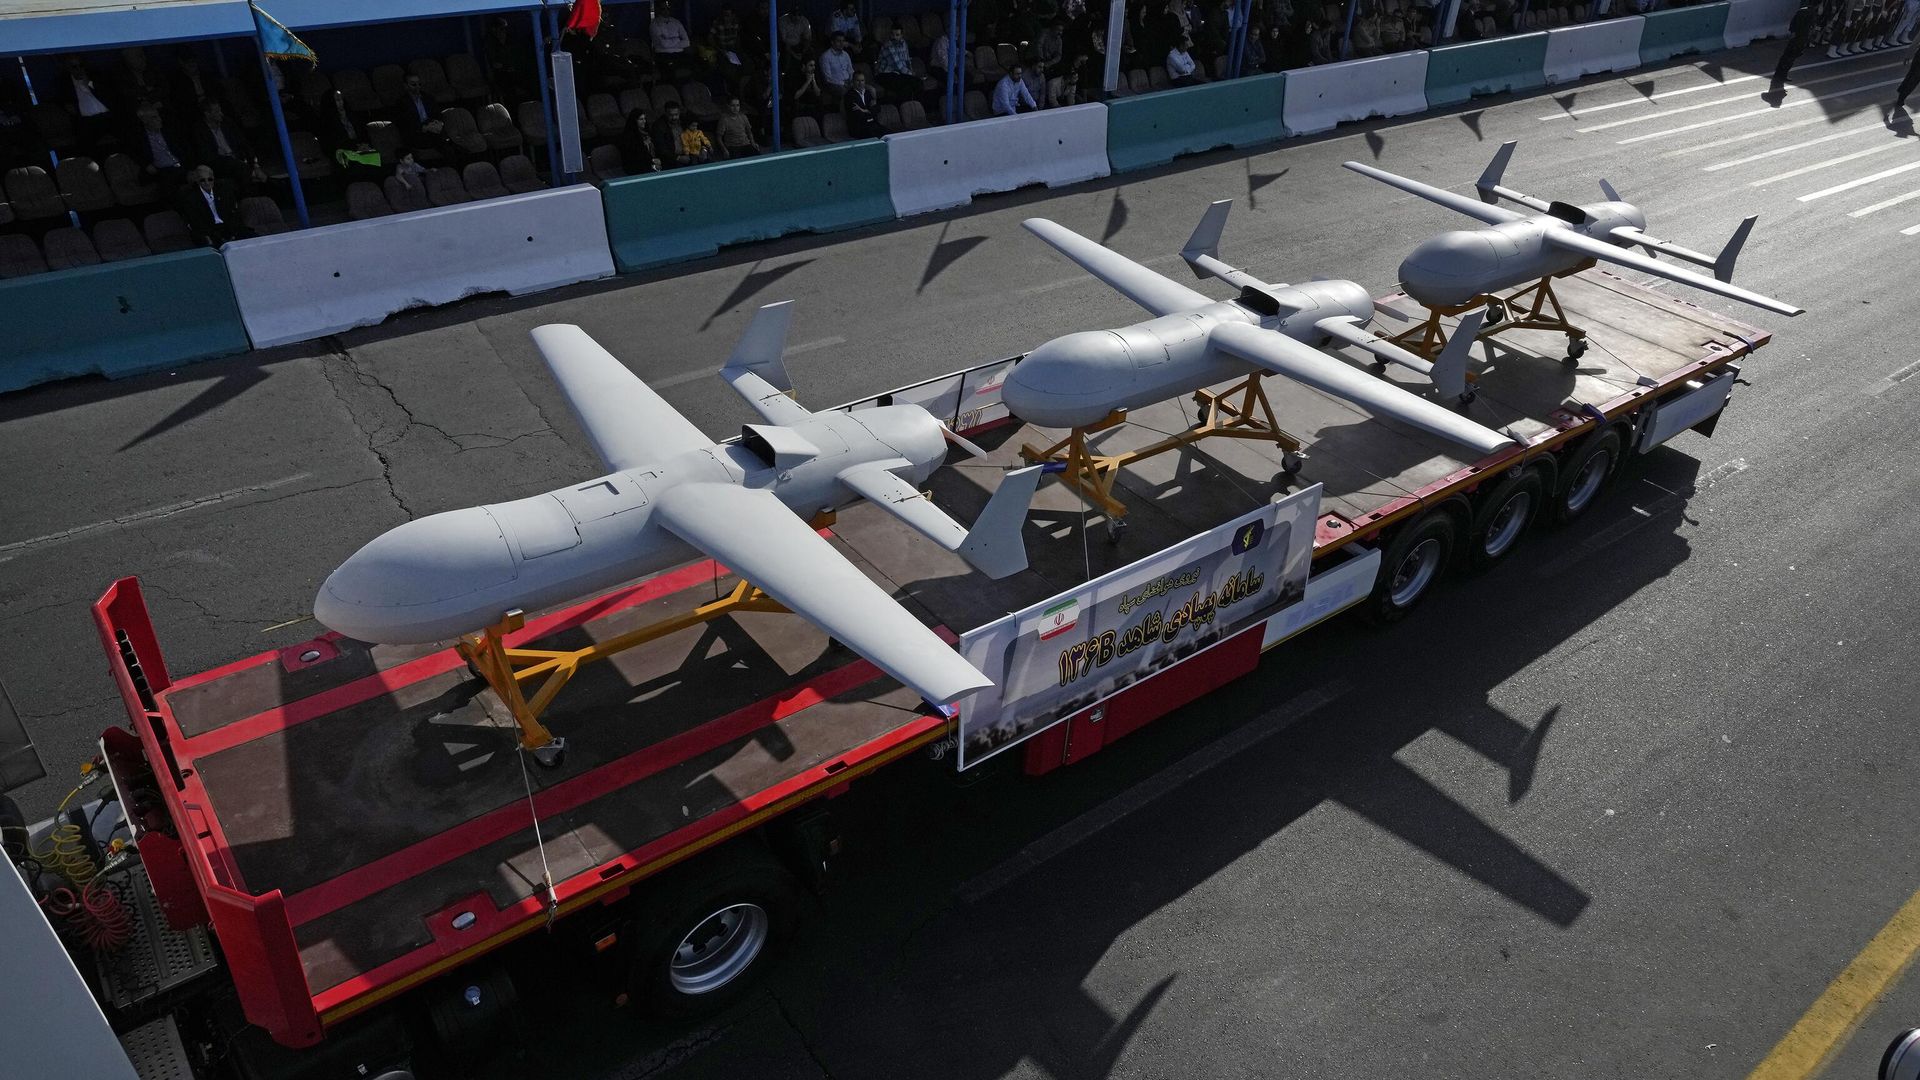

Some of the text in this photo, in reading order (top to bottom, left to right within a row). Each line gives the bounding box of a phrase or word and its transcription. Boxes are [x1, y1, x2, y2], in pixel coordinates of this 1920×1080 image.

[1217, 566, 1264, 608] سامانه
[1117, 611, 1163, 657] شاهد
[1162, 591, 1218, 643] پهپادی
